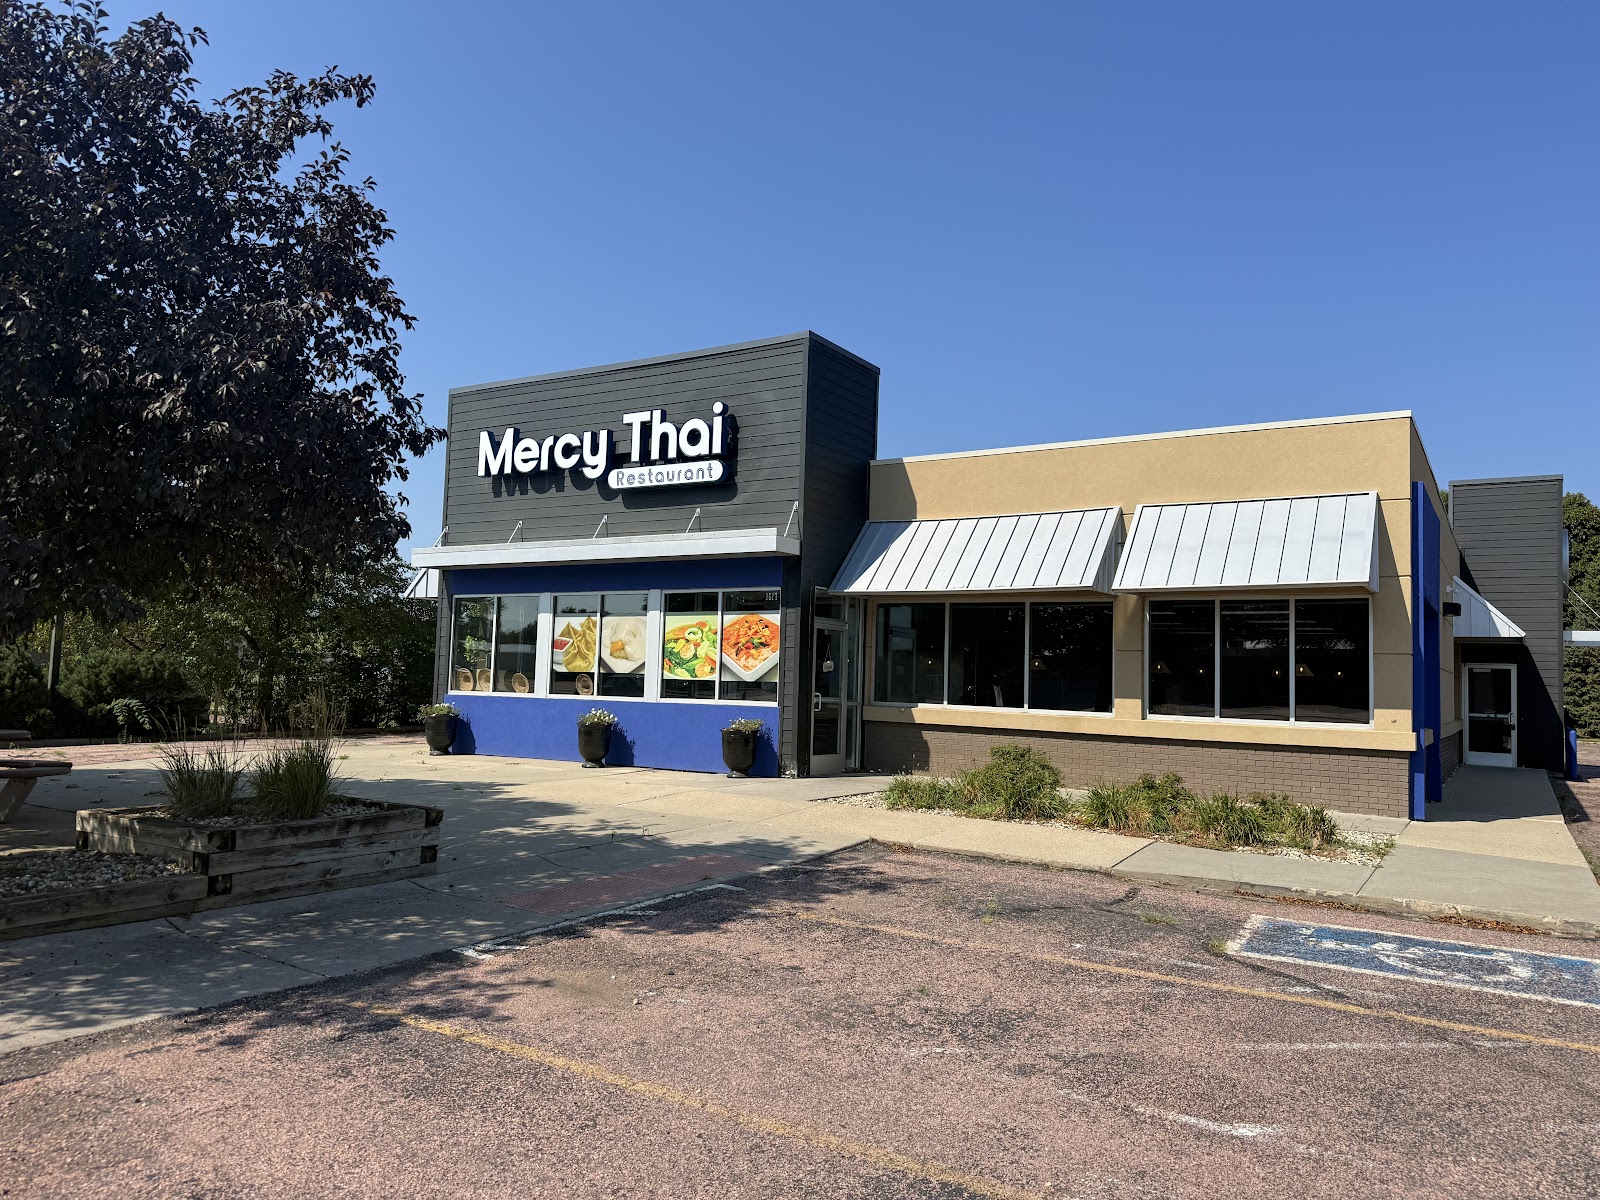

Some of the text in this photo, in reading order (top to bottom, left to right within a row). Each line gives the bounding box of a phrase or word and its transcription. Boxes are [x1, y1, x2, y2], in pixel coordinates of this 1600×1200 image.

[478, 401, 722, 479] Mercy Thai
[616, 462, 714, 486] Restaurant
